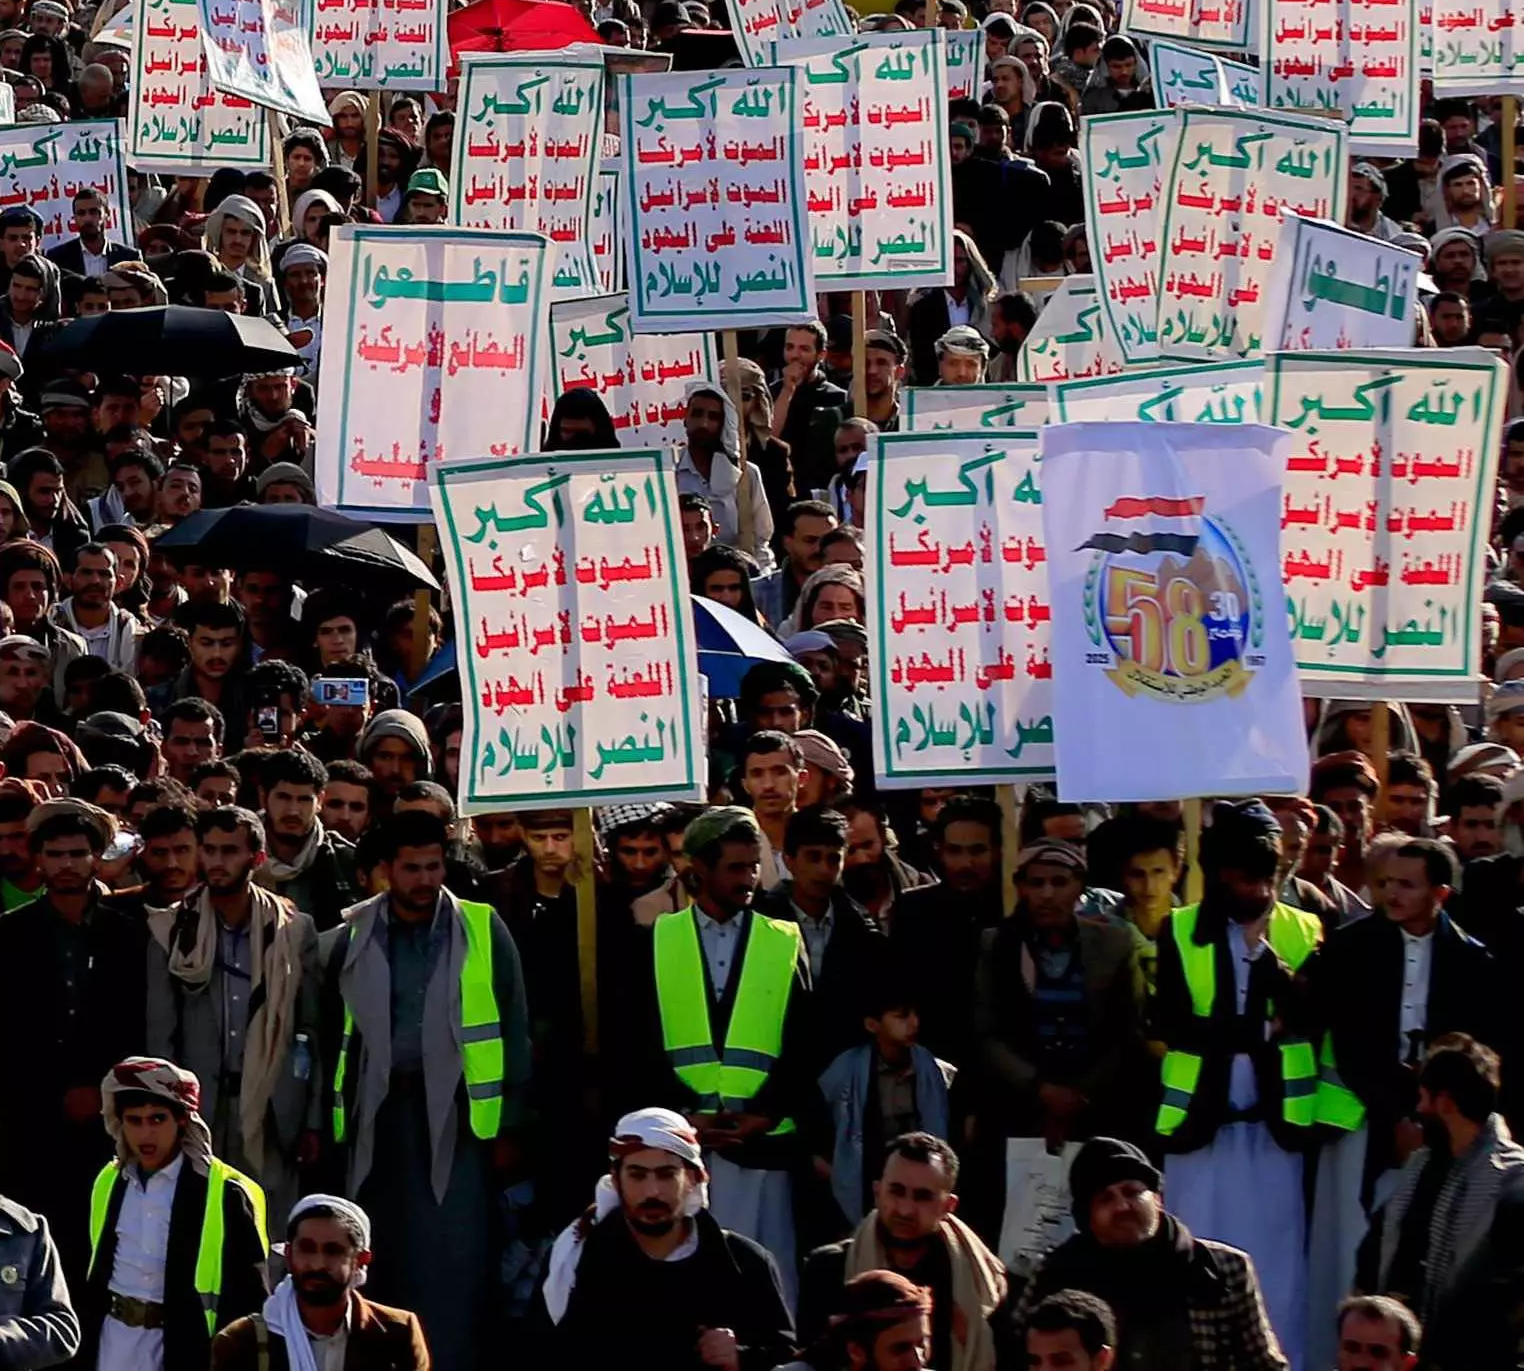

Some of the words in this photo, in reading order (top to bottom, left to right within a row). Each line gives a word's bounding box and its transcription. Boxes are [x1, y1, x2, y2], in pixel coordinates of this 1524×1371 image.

[316, 21, 359, 45] اليهود
[364, 22, 388, 46] على
[394, 20, 432, 44] اللعنة
[379, 51, 432, 85] النصر
[876, 44, 929, 80] الله
[635, 73, 727, 132] أكبر
[732, 79, 786, 117] الله
[867, 99, 930, 130] الموت
[638, 129, 717, 166] لأمريكا
[724, 136, 785, 165] الموت
[869, 141, 932, 173] الموت
[642, 178, 720, 212] لإسرائيل
[727, 179, 786, 206] الموت
[848, 185, 878, 217] على
[886, 182, 934, 208] اللعنة
[643, 222, 697, 255] اليهود
[705, 220, 735, 252] على
[745, 219, 790, 244] اللعنة
[869, 217, 934, 264] النصر
[365, 253, 529, 308] قاطعوا
[647, 258, 721, 306] للإسلام
[729, 255, 794, 304] النصر
[357, 322, 446, 373] الأمريكية
[447, 328, 524, 377] البضائع
[429, 389, 441, 423] و
[1282, 370, 1405, 435] أكبر
[1408, 378, 1482, 425] الله
[888, 443, 1006, 525] أكبر
[1390, 449, 1473, 485] الموت
[465, 467, 570, 550] أكبر
[584, 472, 657, 524] الله
[1385, 501, 1468, 540] الموت
[469, 543, 567, 598] لأمريكا
[574, 546, 663, 592] الموت
[889, 521, 992, 574] لأمريكا
[1399, 552, 1462, 586] اللعنة
[1352, 556, 1389, 592] على
[476, 609, 572, 659] لإسرائيل
[580, 603, 669, 651] الموت
[890, 587, 996, 635] لإسرائيل
[1374, 599, 1459, 658] النصر
[606, 660, 673, 700] اللعنة
[891, 648, 965, 692] اليهود
[975, 644, 1016, 690] على
[481, 671, 545, 717] اليهود
[555, 667, 596, 714] على
[481, 721, 576, 783] للإسلام
[589, 711, 676, 779] النصر
[896, 702, 996, 761] للإسلام
